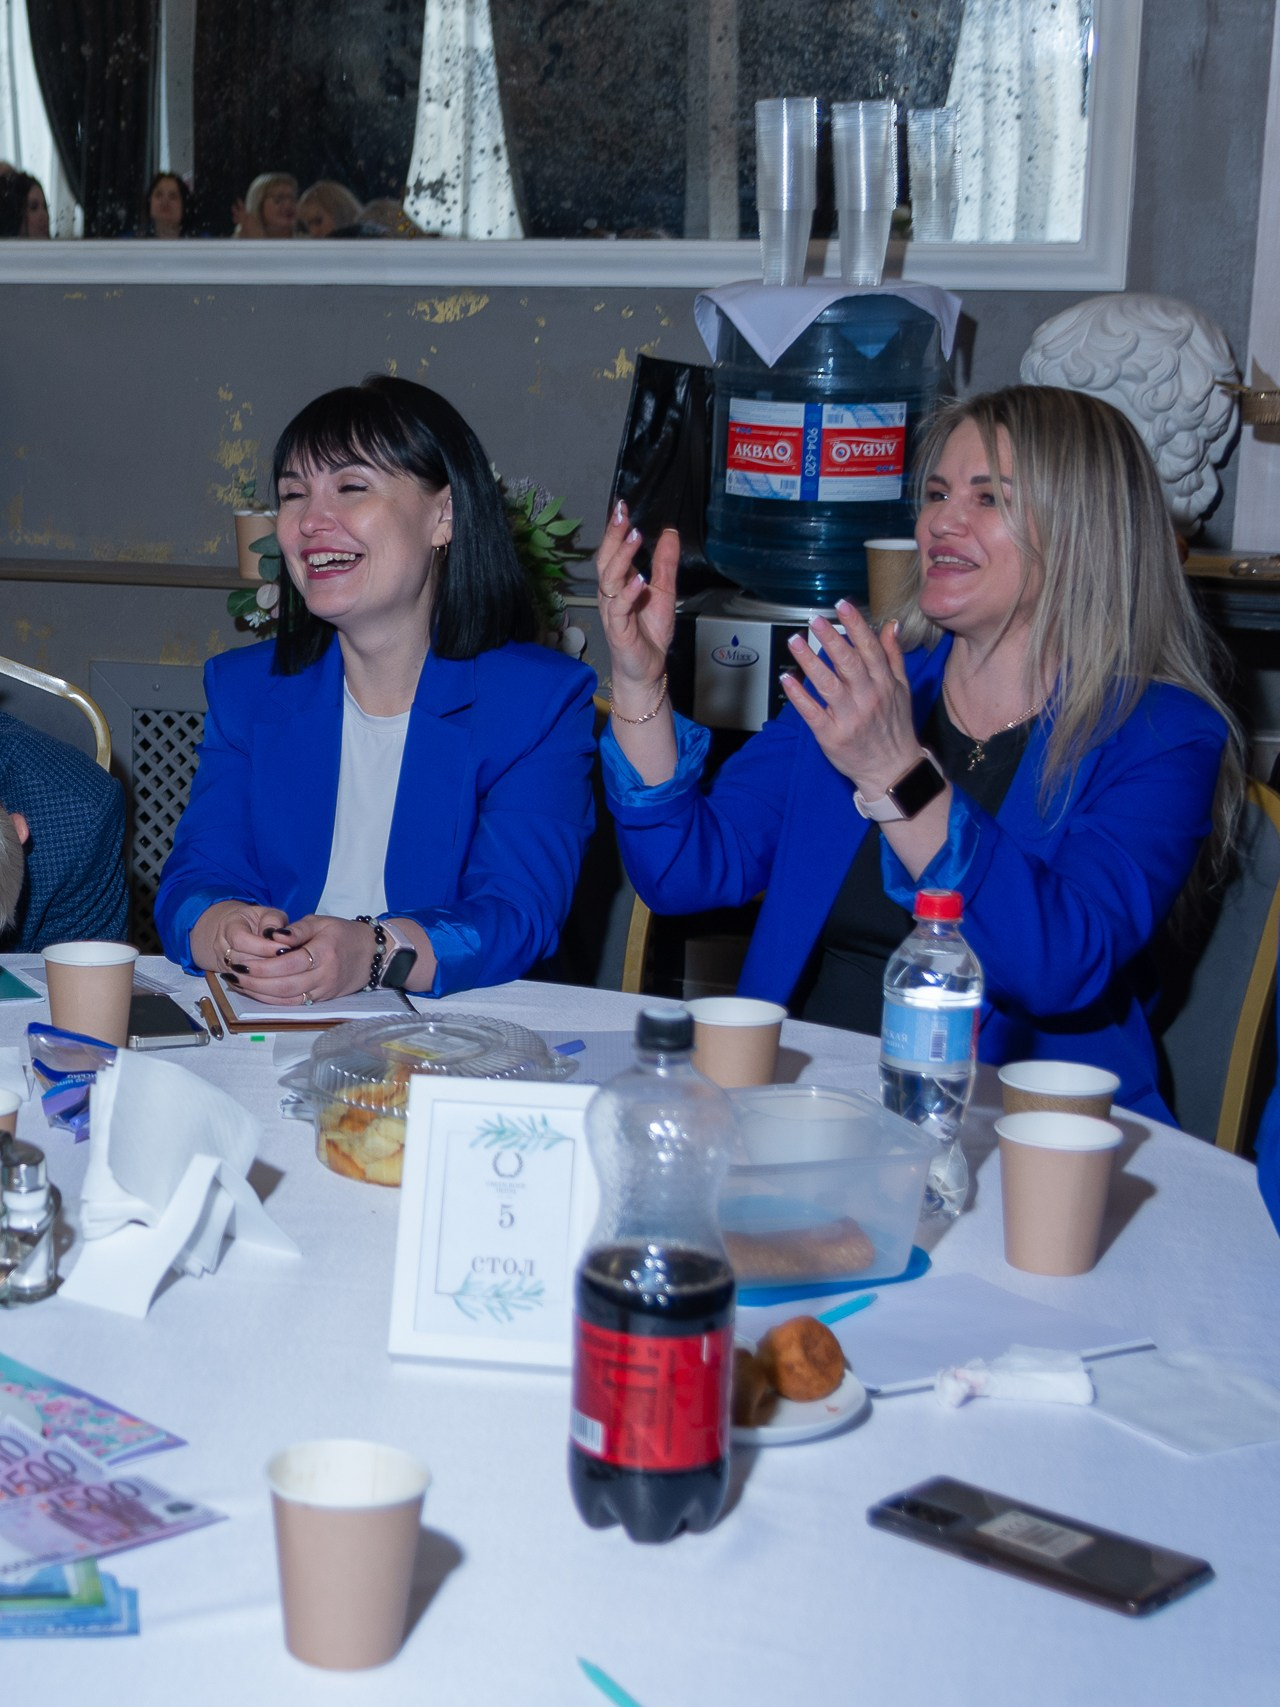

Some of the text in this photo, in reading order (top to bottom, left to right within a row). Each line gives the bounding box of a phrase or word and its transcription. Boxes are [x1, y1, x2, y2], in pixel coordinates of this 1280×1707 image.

[805, 428, 818, 476] 904-620
[498, 1203, 515, 1229] 5
[6, 1450, 77, 1494] 500
